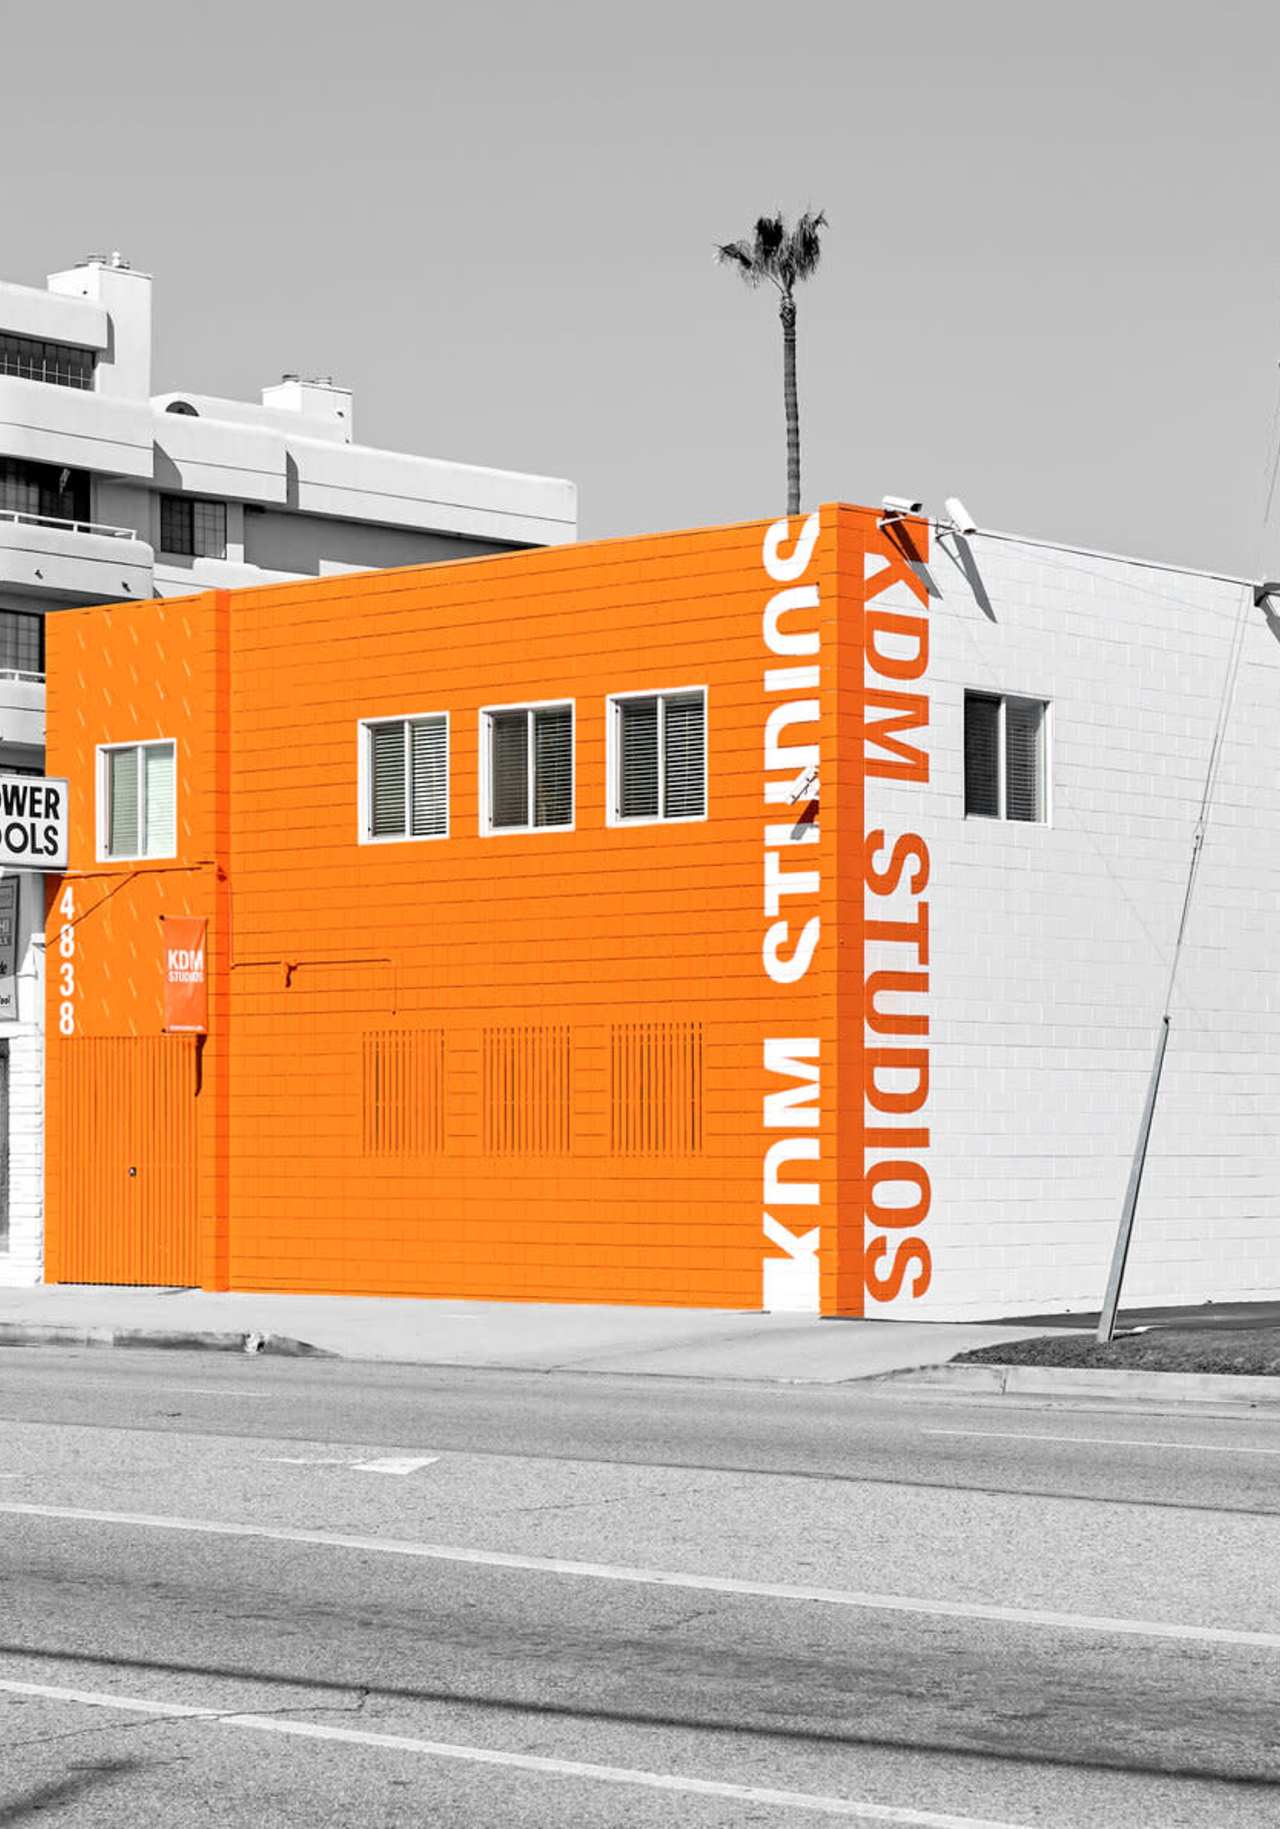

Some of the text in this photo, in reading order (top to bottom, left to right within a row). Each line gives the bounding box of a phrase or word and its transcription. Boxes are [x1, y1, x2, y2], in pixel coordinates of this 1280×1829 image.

[864, 511, 929, 785] KDM
[168, 949, 204, 971] KDM
[864, 828, 932, 1303] STUDIOS
